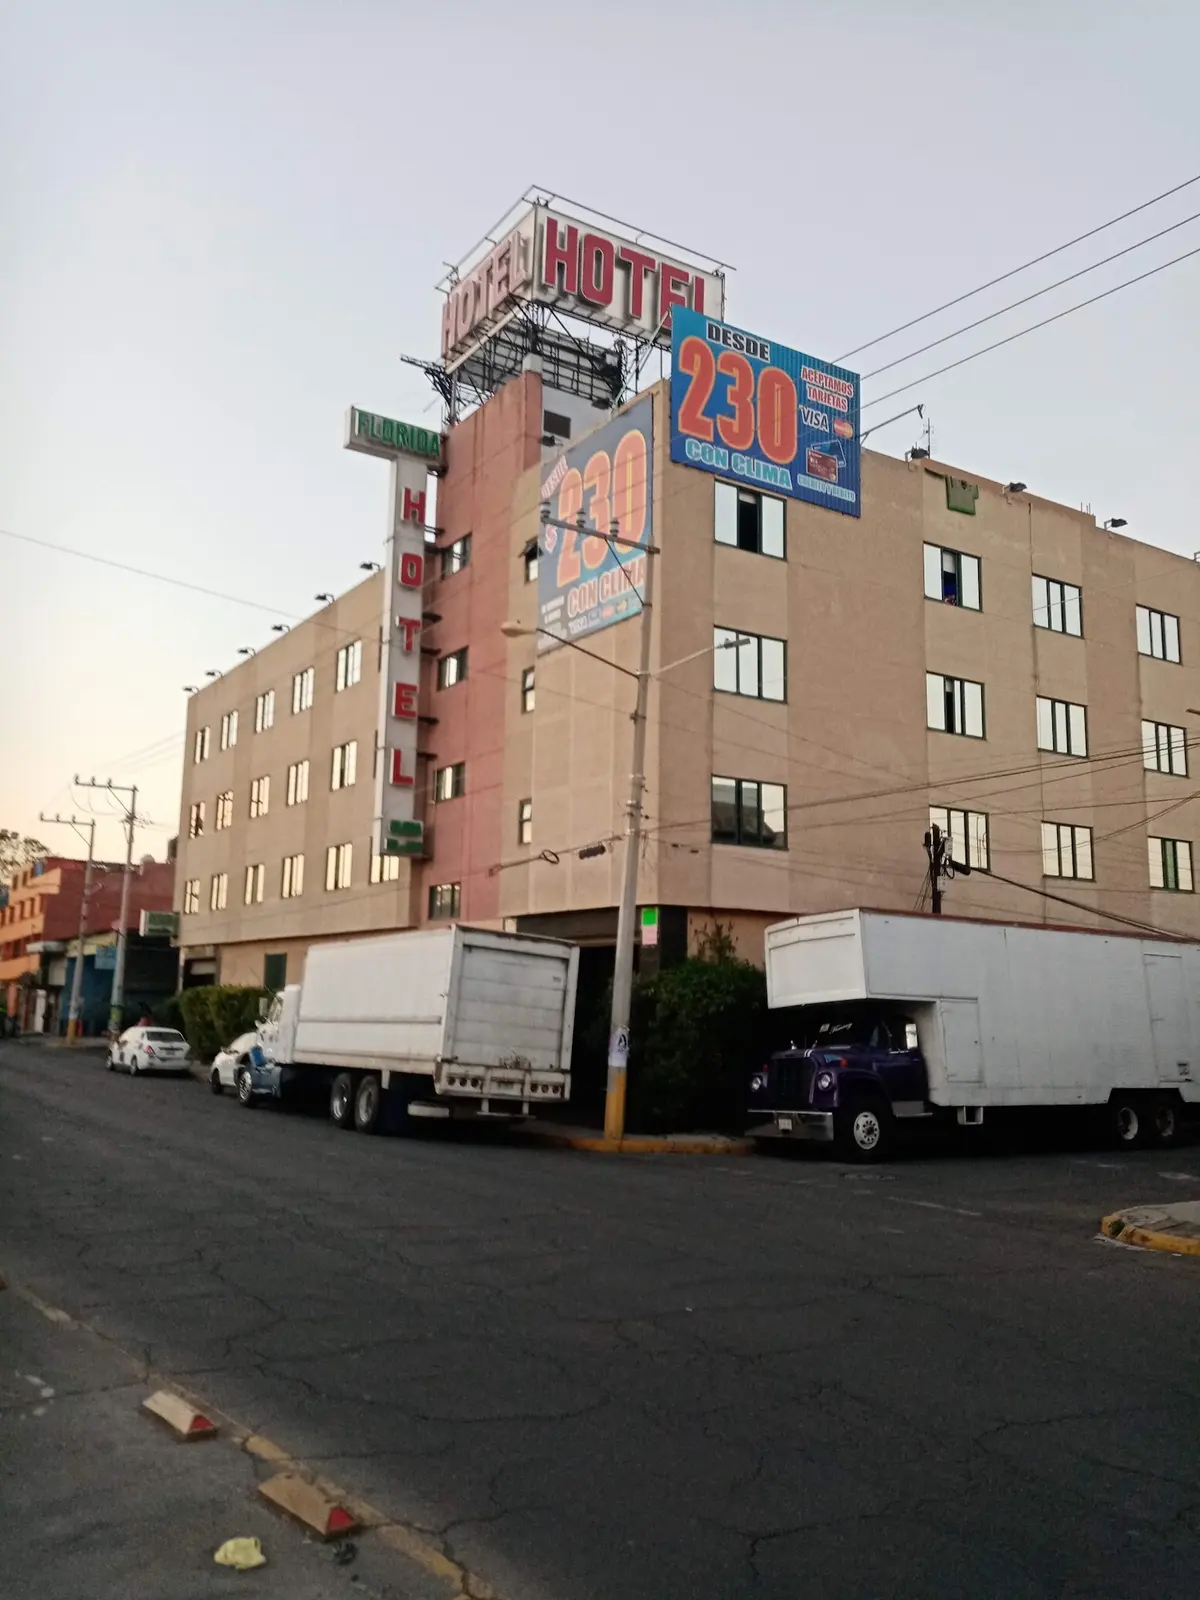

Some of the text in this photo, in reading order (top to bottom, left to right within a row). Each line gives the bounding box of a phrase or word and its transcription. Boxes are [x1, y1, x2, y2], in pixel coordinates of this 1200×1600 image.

[441, 231, 526, 357] HOTEL
[707, 322, 769, 361] DESDE
[678, 336, 797, 464] 230
[802, 366, 853, 397] ACEPTAMOS
[355, 410, 440, 456] FLORIDA
[801, 406, 829, 432] VISA
[685, 438, 728, 470] CON
[731, 453, 792, 490] CLIMA
[557, 429, 647, 588] 230
[567, 577, 598, 618] CON
[390, 487, 426, 785] HOTEL
